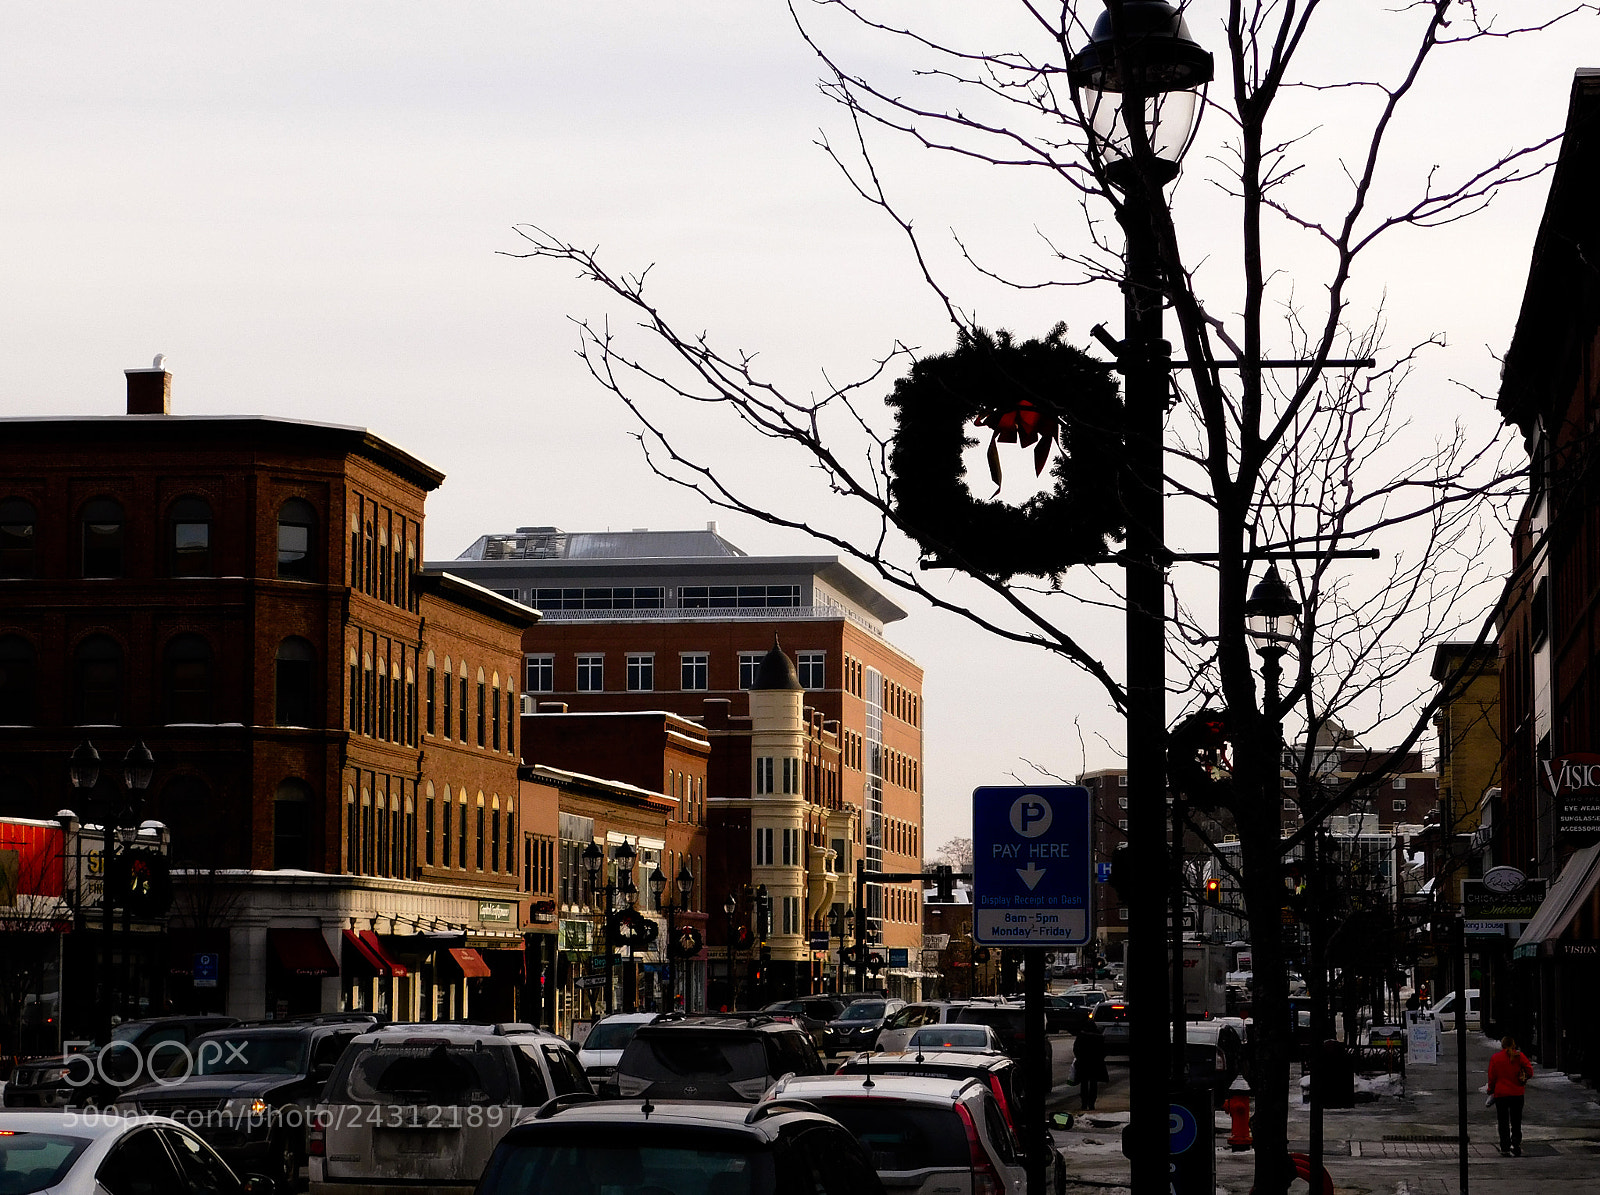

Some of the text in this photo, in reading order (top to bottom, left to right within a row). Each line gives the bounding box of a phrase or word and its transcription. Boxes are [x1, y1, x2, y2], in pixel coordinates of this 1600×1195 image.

[992, 843, 1070, 859] PAY HERE
[981, 894, 1082, 906] Display Receipt on Dash
[1564, 945, 1597, 954] VISION
